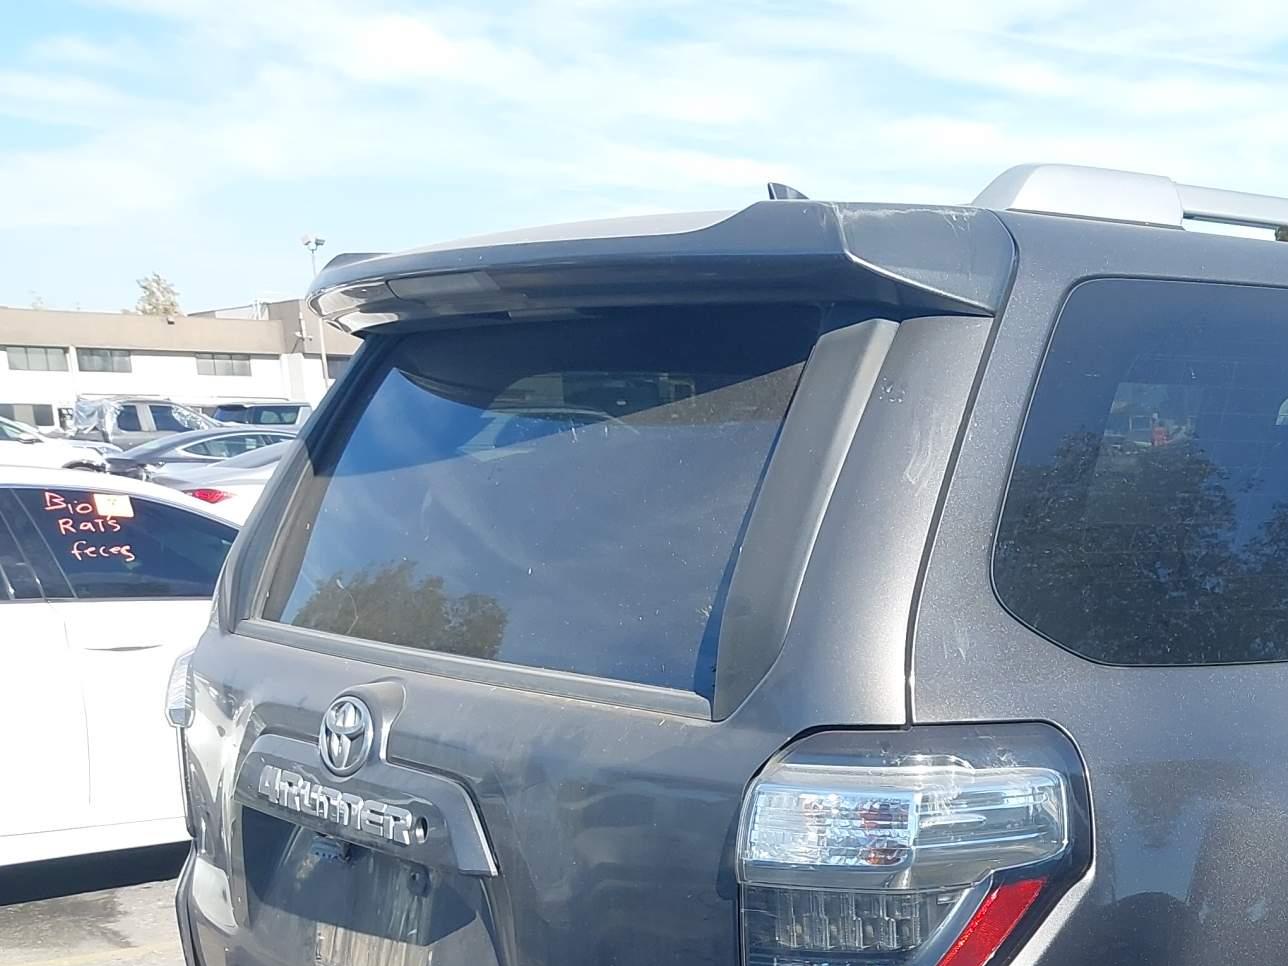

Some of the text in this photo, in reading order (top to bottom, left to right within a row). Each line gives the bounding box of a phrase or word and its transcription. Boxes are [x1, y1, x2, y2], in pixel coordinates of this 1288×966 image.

[44, 491, 93, 515] Bio
[71, 540, 136, 562] feces
[258, 764, 413, 846] 4RUNNER
